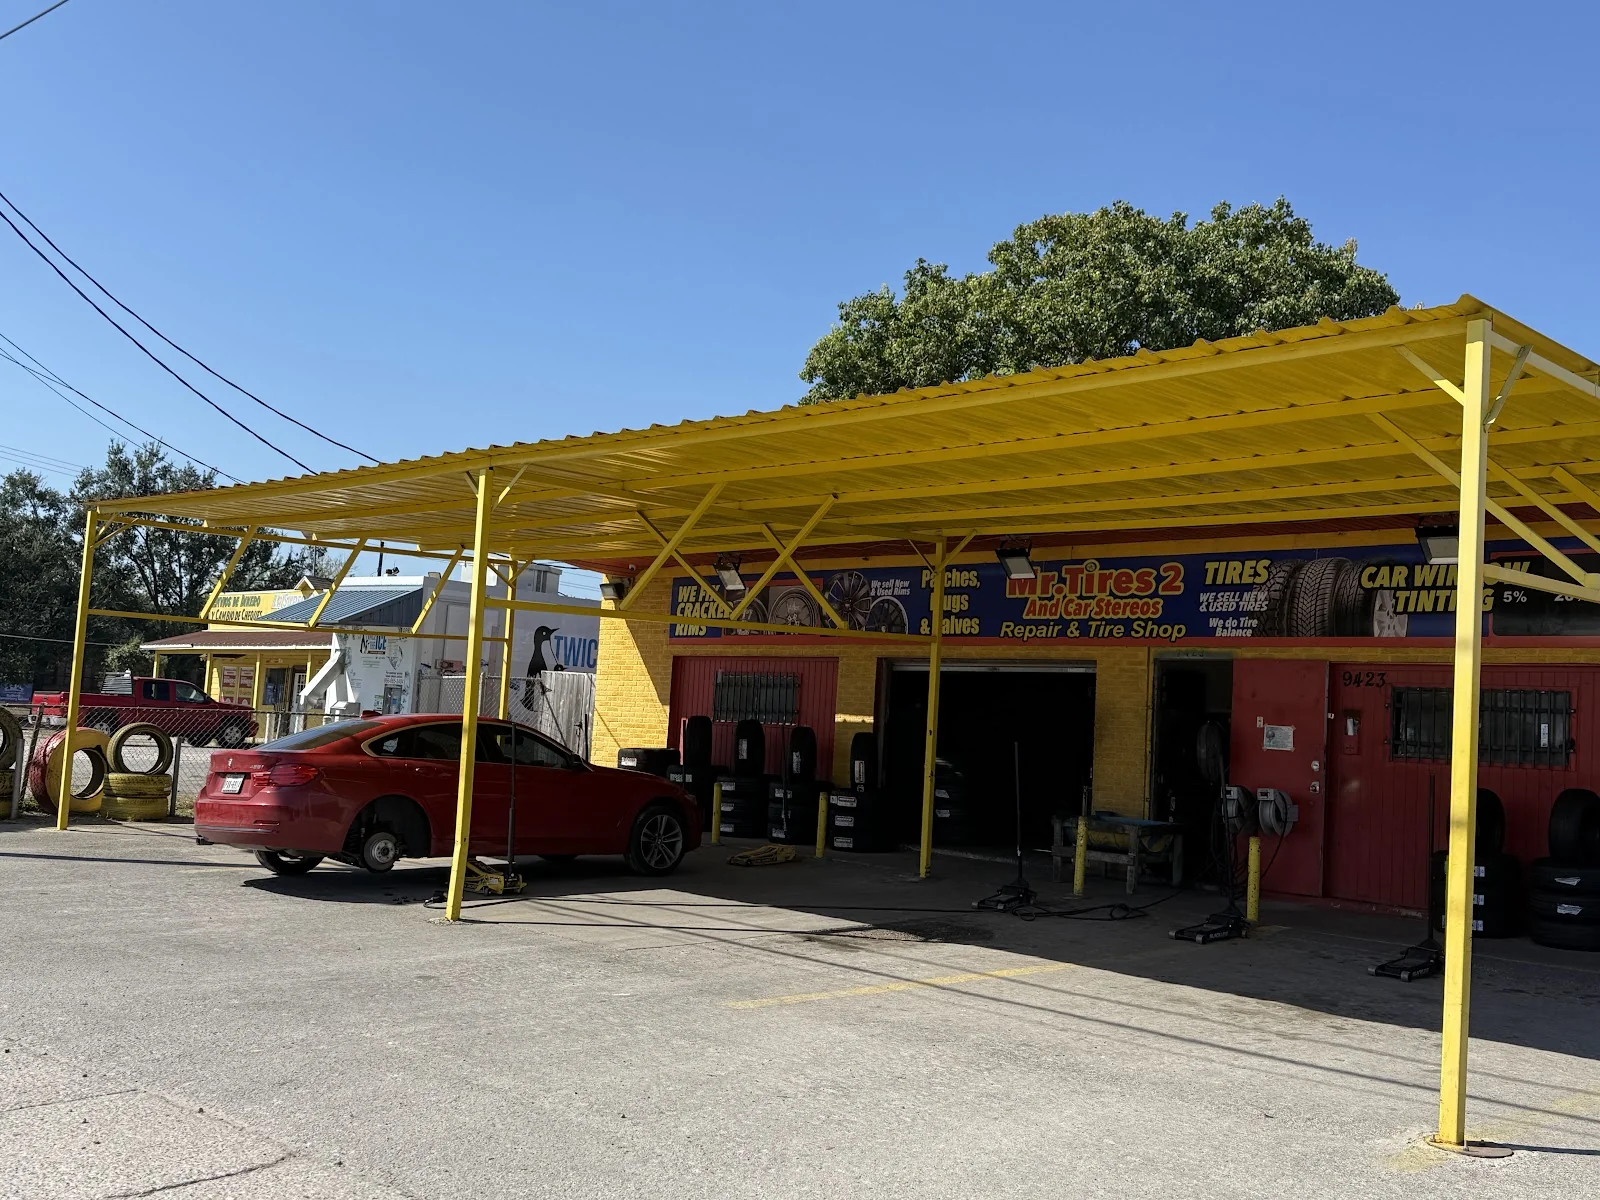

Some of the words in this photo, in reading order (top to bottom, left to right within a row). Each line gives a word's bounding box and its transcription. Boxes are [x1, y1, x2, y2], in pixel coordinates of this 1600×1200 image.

[921, 568, 981, 589] Paches,
[1158, 561, 1185, 595] 2
[1204, 559, 1272, 585] TIRES
[1360, 566, 1409, 589] CAR
[870, 588, 876, 597] &
[876, 587, 893, 597] Used
[893, 587, 911, 596] Rims
[871, 579, 882, 589] We
[882, 578, 895, 588] sell
[895, 579, 911, 588] New
[678, 585, 698, 603] WE
[930, 592, 969, 614] ugs
[1199, 592, 1216, 603] WE
[1216, 591, 1241, 602] SELL
[1242, 591, 1268, 602] NEW
[1395, 588, 1495, 613] TINTIG
[1502, 590, 1528, 603] 5%
[1023, 596, 1062, 620] And
[1062, 596, 1093, 619] Car
[1092, 595, 1164, 619] Stereos
[1199, 602, 1208, 613] &
[1208, 601, 1237, 612] USED
[1238, 601, 1269, 612] TIRES
[675, 622, 707, 636] RIMS
[919, 617, 931, 635] &
[938, 615, 980, 635] alves
[1000, 621, 1062, 641] Repair
[1066, 621, 1080, 638] &
[1087, 620, 1125, 638] Tire
[1130, 620, 1187, 642] Shop
[1208, 617, 1224, 628] We
[1225, 616, 1238, 628] do
[1239, 616, 1259, 628] Tire
[1215, 627, 1253, 637] Balance
[1342, 671, 1386, 688] 9423
